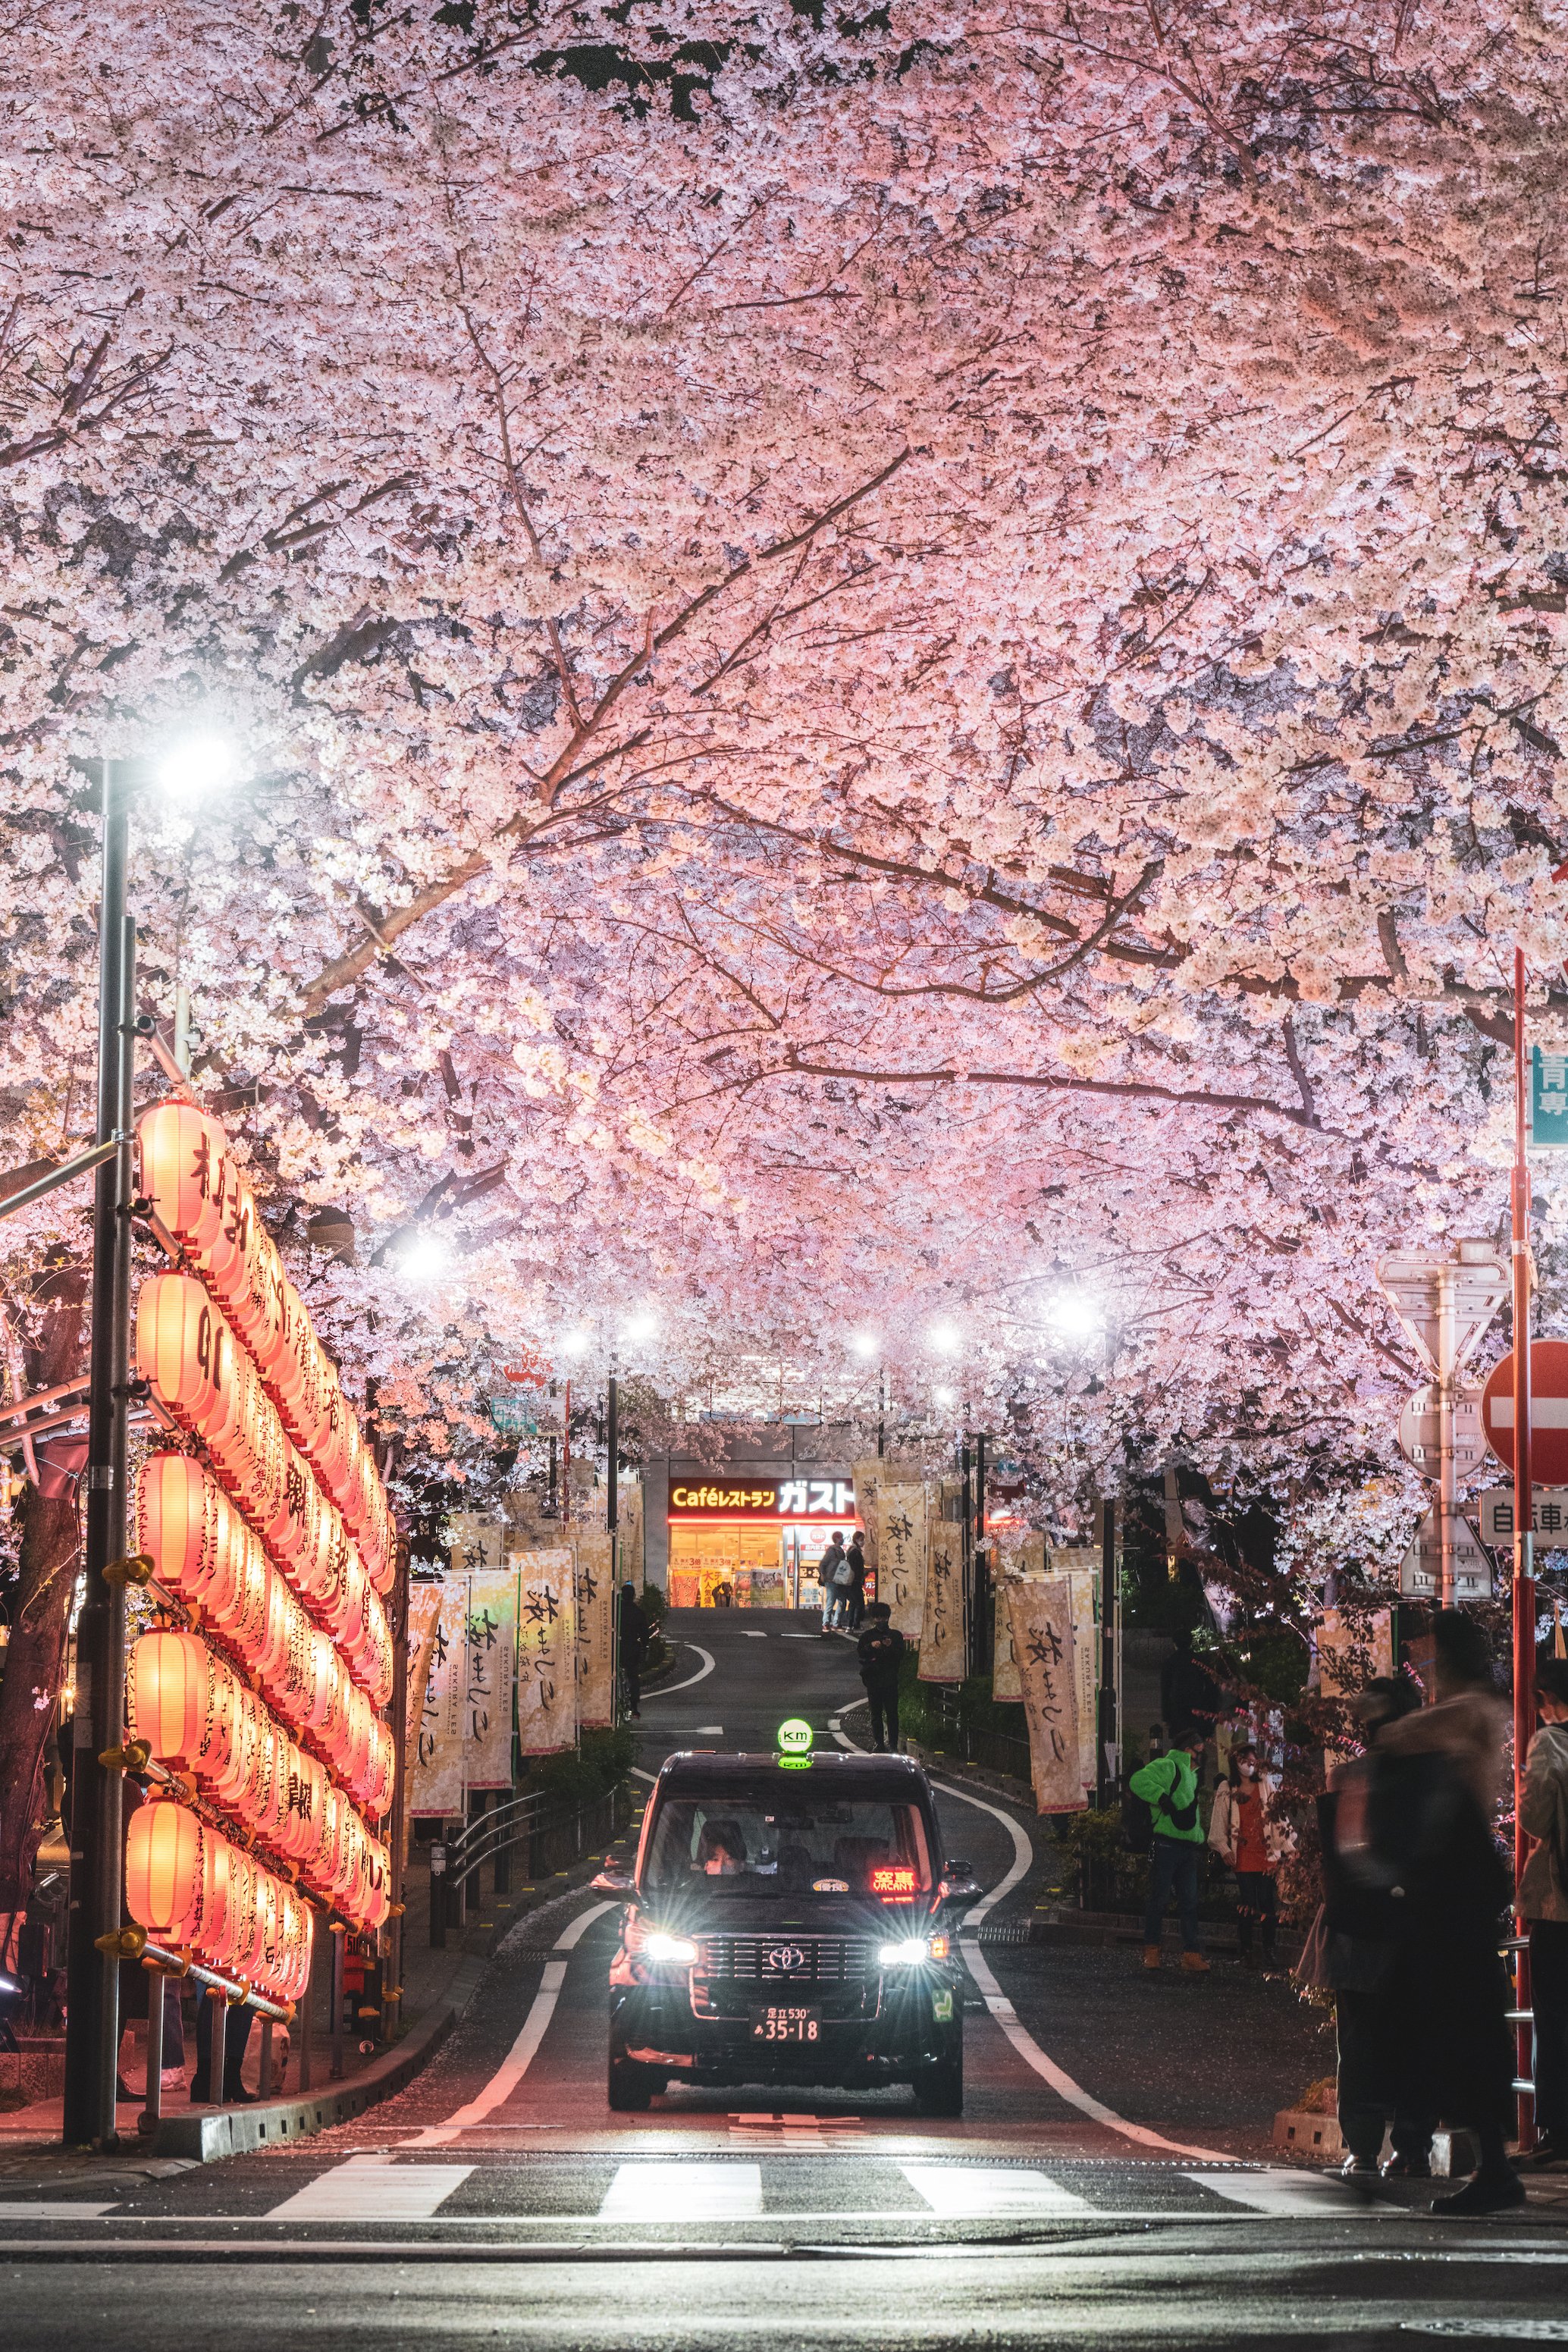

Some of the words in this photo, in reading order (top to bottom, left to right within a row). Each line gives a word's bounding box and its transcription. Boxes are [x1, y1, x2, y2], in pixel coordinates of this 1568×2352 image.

[673, 1487, 775, 1507] Caféレストラン
[779, 1479, 855, 1514] ガスト
[1494, 1502, 1568, 1535] 自車
[784, 1731, 807, 1740] km
[874, 1871, 914, 1883] 空車
[873, 1882, 914, 1891] VACANT
[767, 2008, 787, 2019] 足立
[789, 2009, 807, 2019] 530
[754, 2024, 764, 2035] あ
[766, 2020, 817, 2040] 35-18
